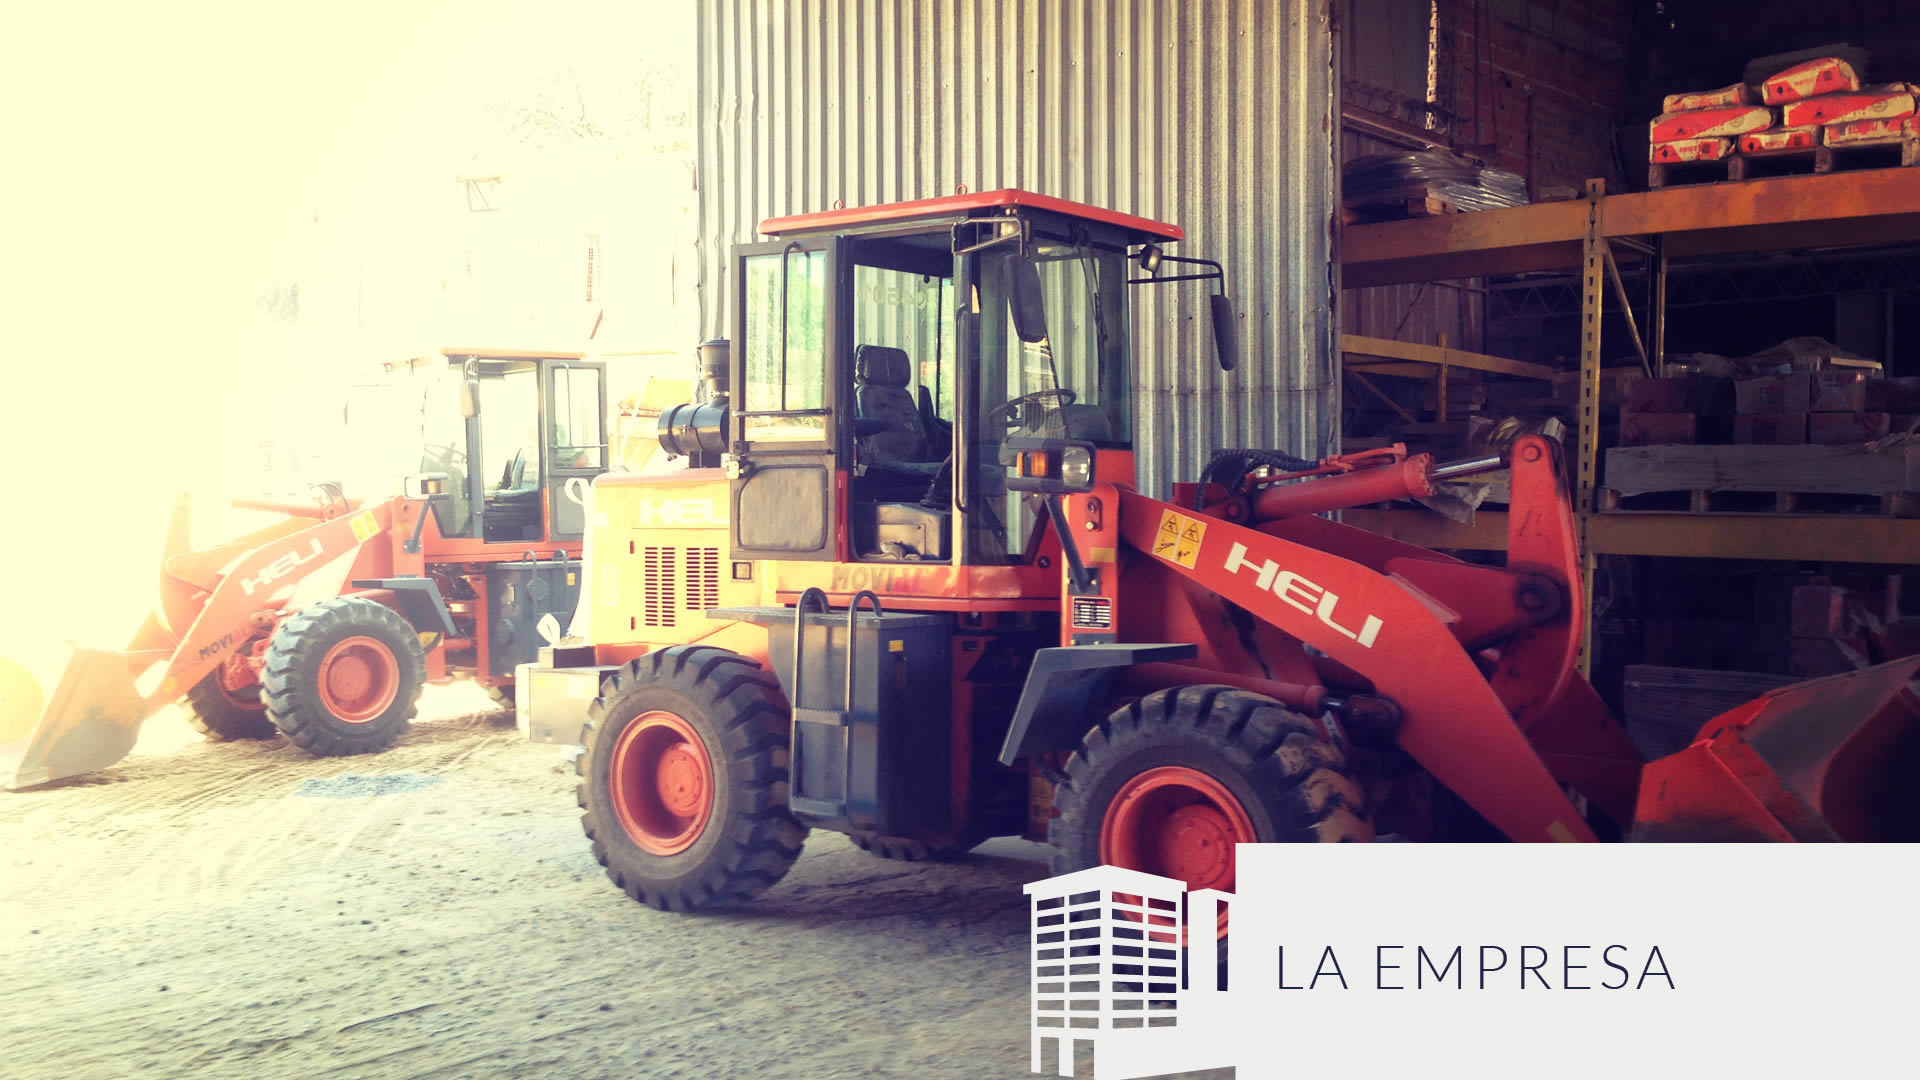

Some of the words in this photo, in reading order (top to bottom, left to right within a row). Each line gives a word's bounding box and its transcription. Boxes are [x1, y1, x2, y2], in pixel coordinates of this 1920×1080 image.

[640, 498, 730, 524] HEL
[240, 538, 324, 596] HELI
[1224, 541, 1384, 649] HELI
